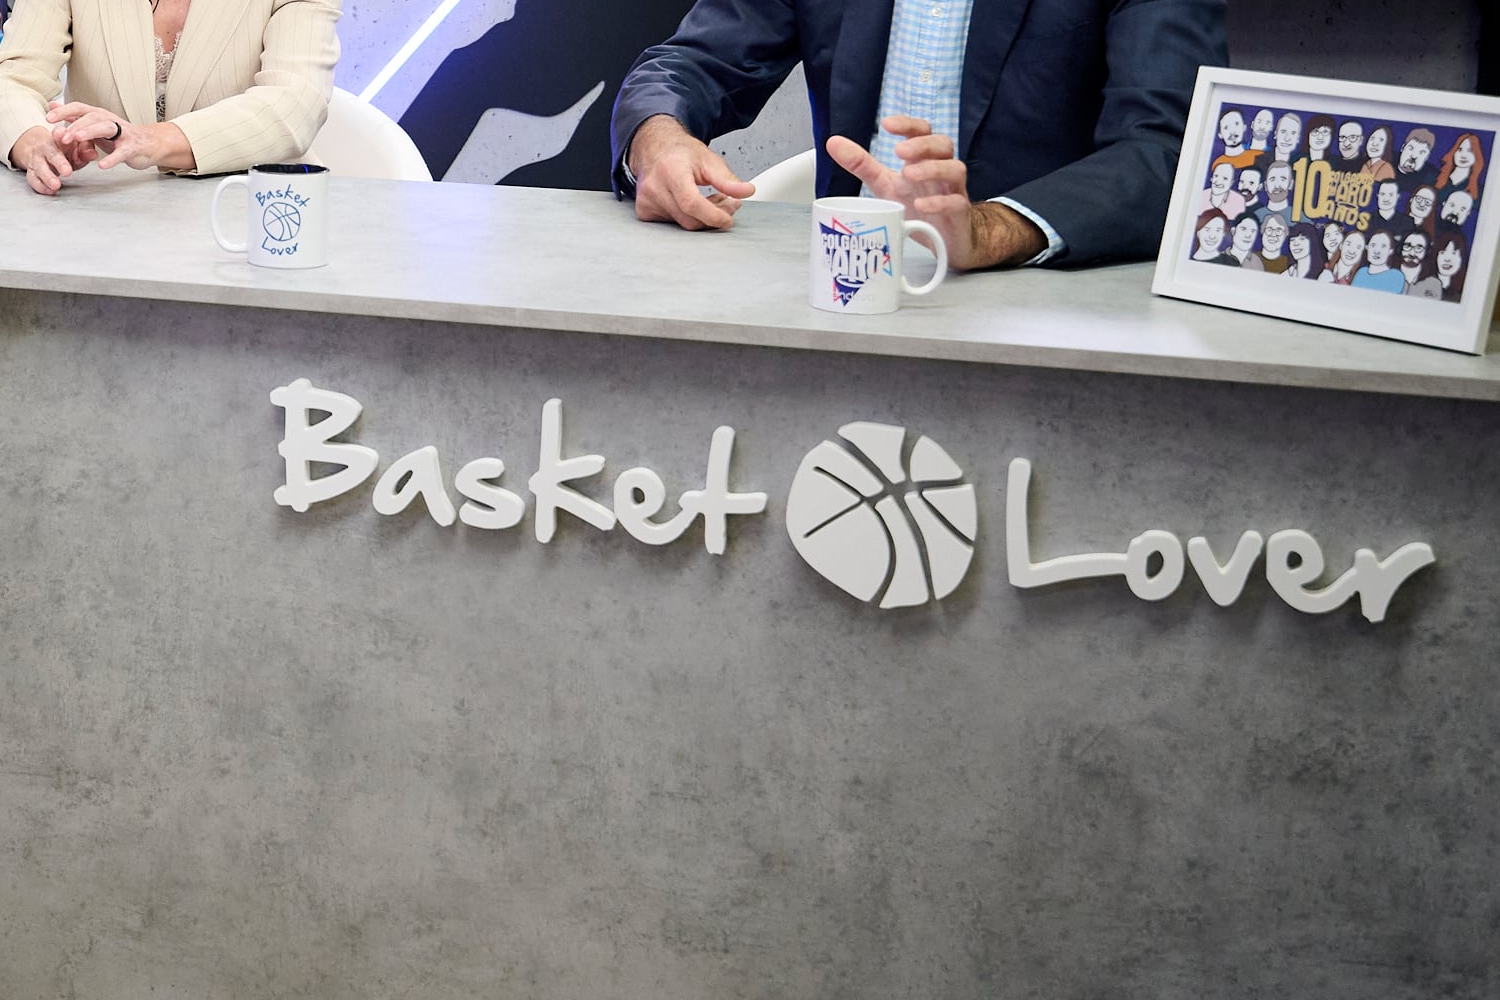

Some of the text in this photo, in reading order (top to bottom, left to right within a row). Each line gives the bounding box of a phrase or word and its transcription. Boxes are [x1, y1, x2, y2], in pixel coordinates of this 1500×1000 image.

[255, 184, 310, 207] Basket
[1291, 157, 1333, 222] 10
[261, 236, 298, 256] Lover
[270, 378, 768, 556] Basket
[1007, 457, 1437, 624] Lover
